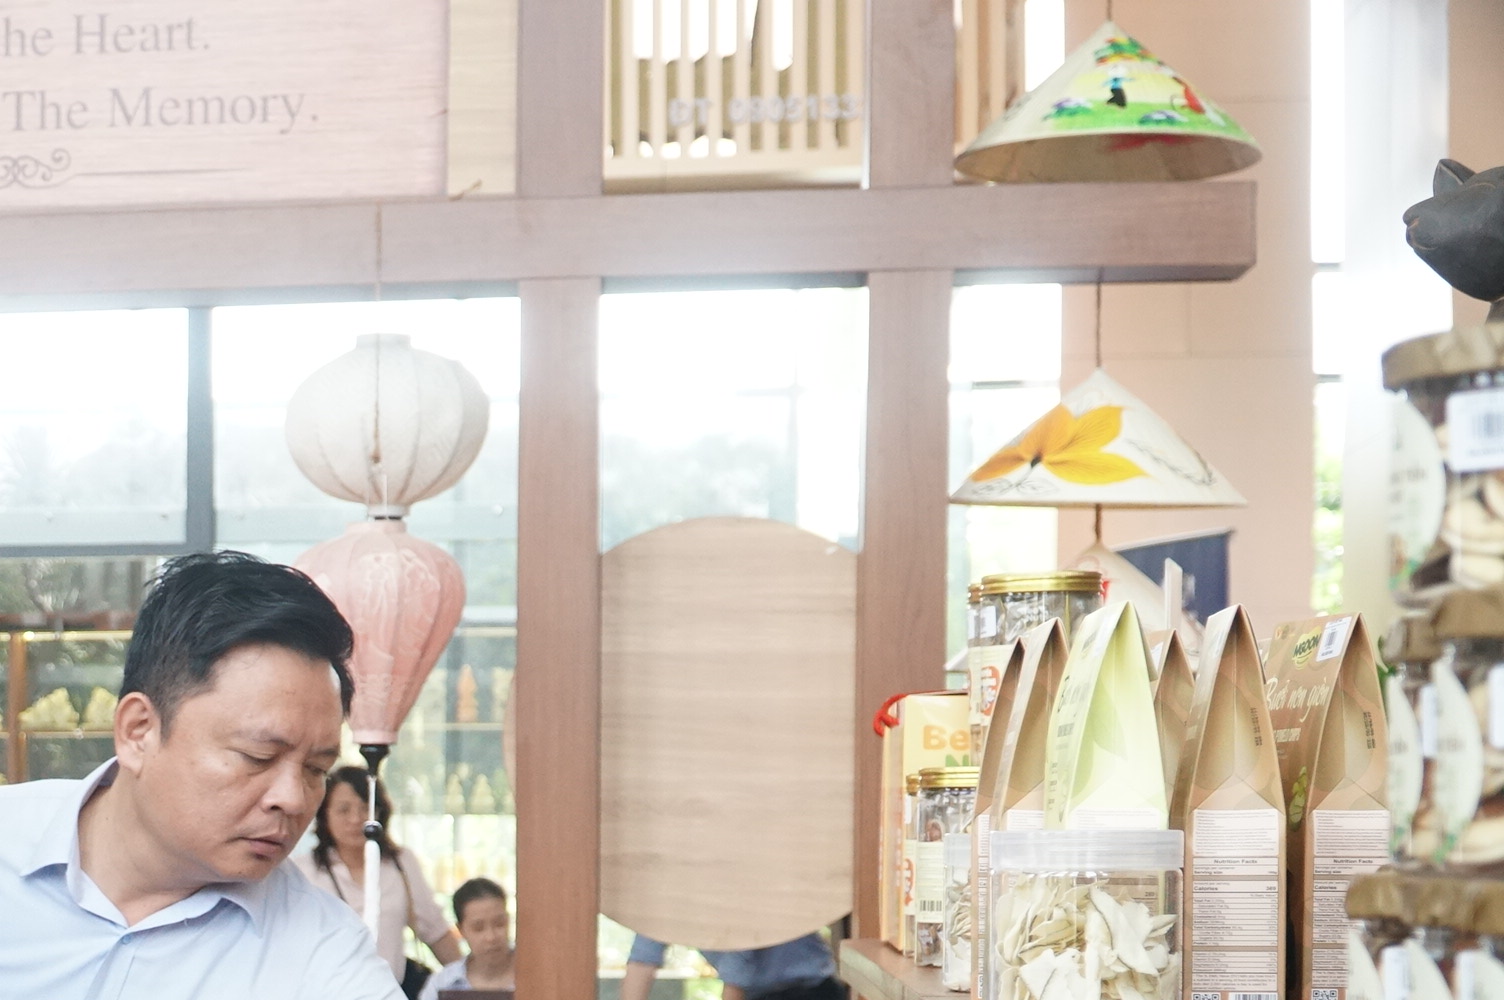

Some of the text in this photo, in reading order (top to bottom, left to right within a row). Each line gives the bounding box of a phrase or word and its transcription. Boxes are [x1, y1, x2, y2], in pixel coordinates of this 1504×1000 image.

[72, 12, 212, 57] Heart.
[1, 89, 90, 133] The
[105, 84, 321, 136] Memory.
